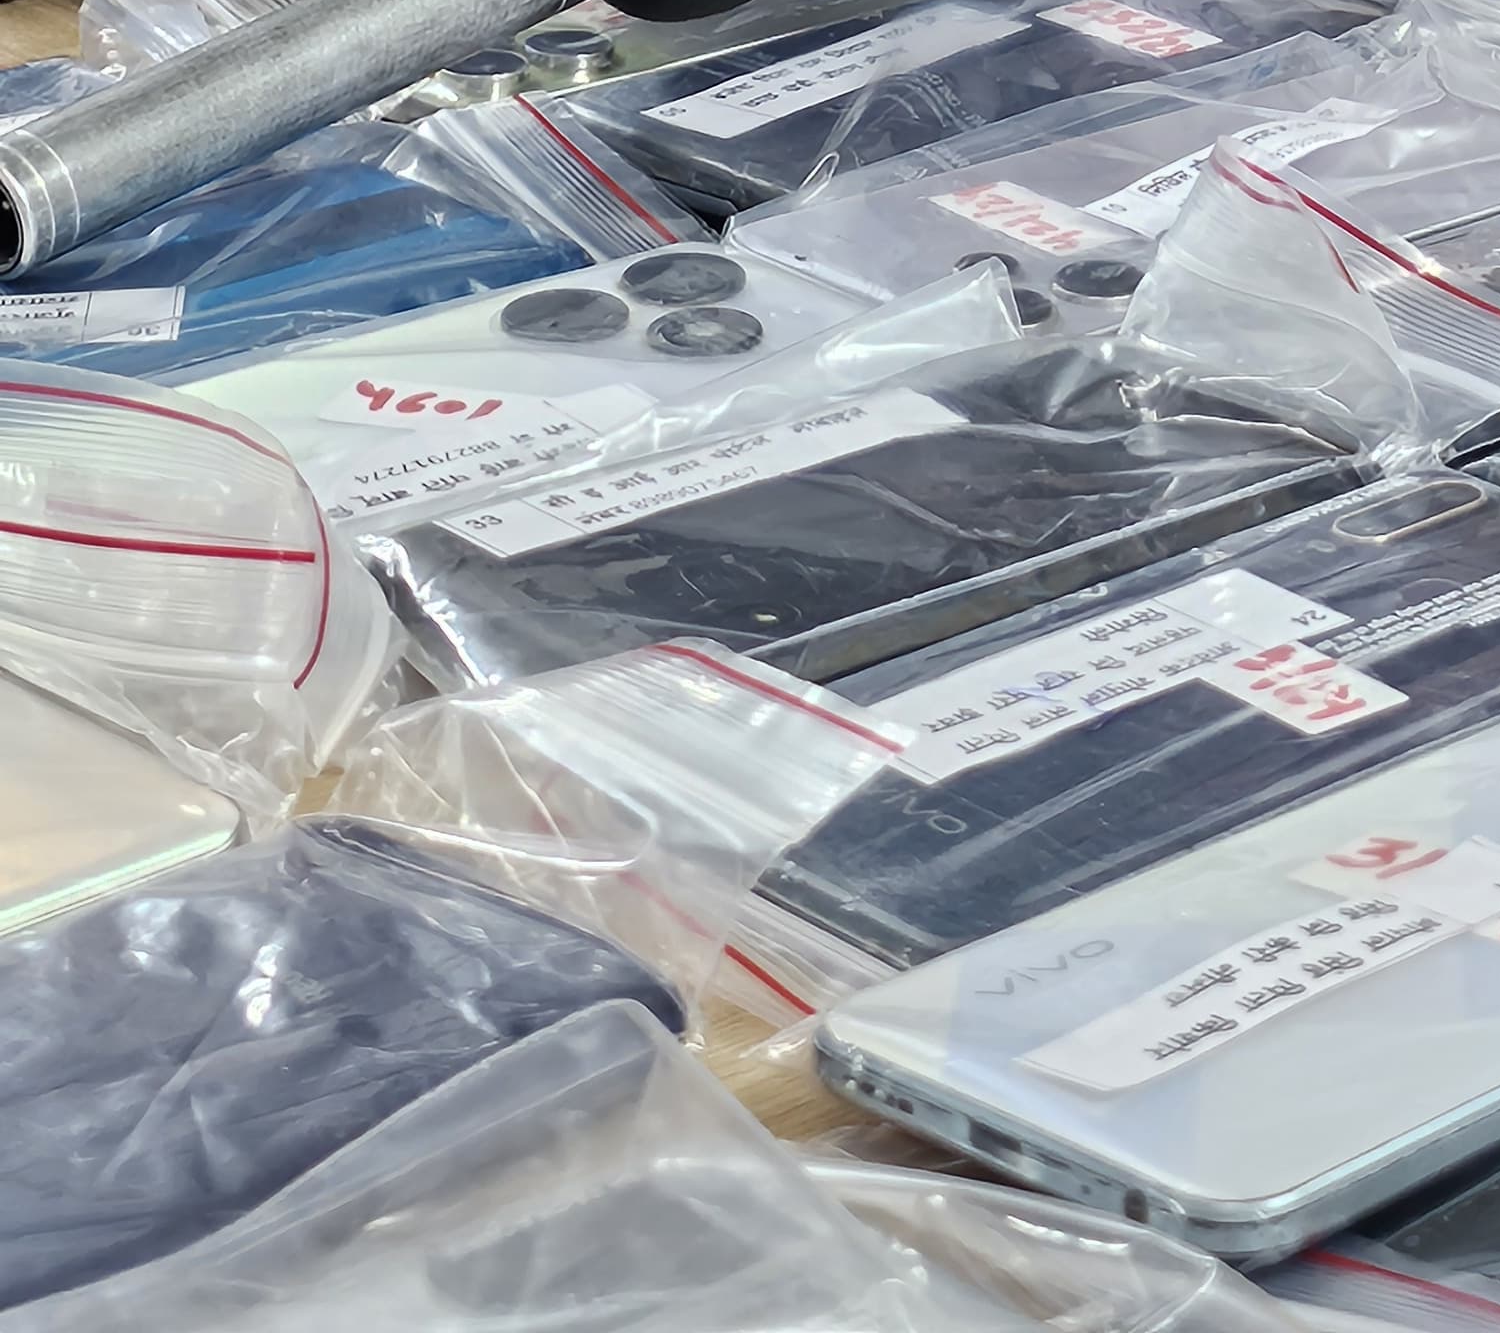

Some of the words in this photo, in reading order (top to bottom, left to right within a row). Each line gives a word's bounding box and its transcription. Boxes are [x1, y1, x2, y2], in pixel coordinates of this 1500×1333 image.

[465, 514, 504, 531] 33
[1302, 950, 1365, 979] सिंह
[1235, 976, 1307, 1014] पिता
